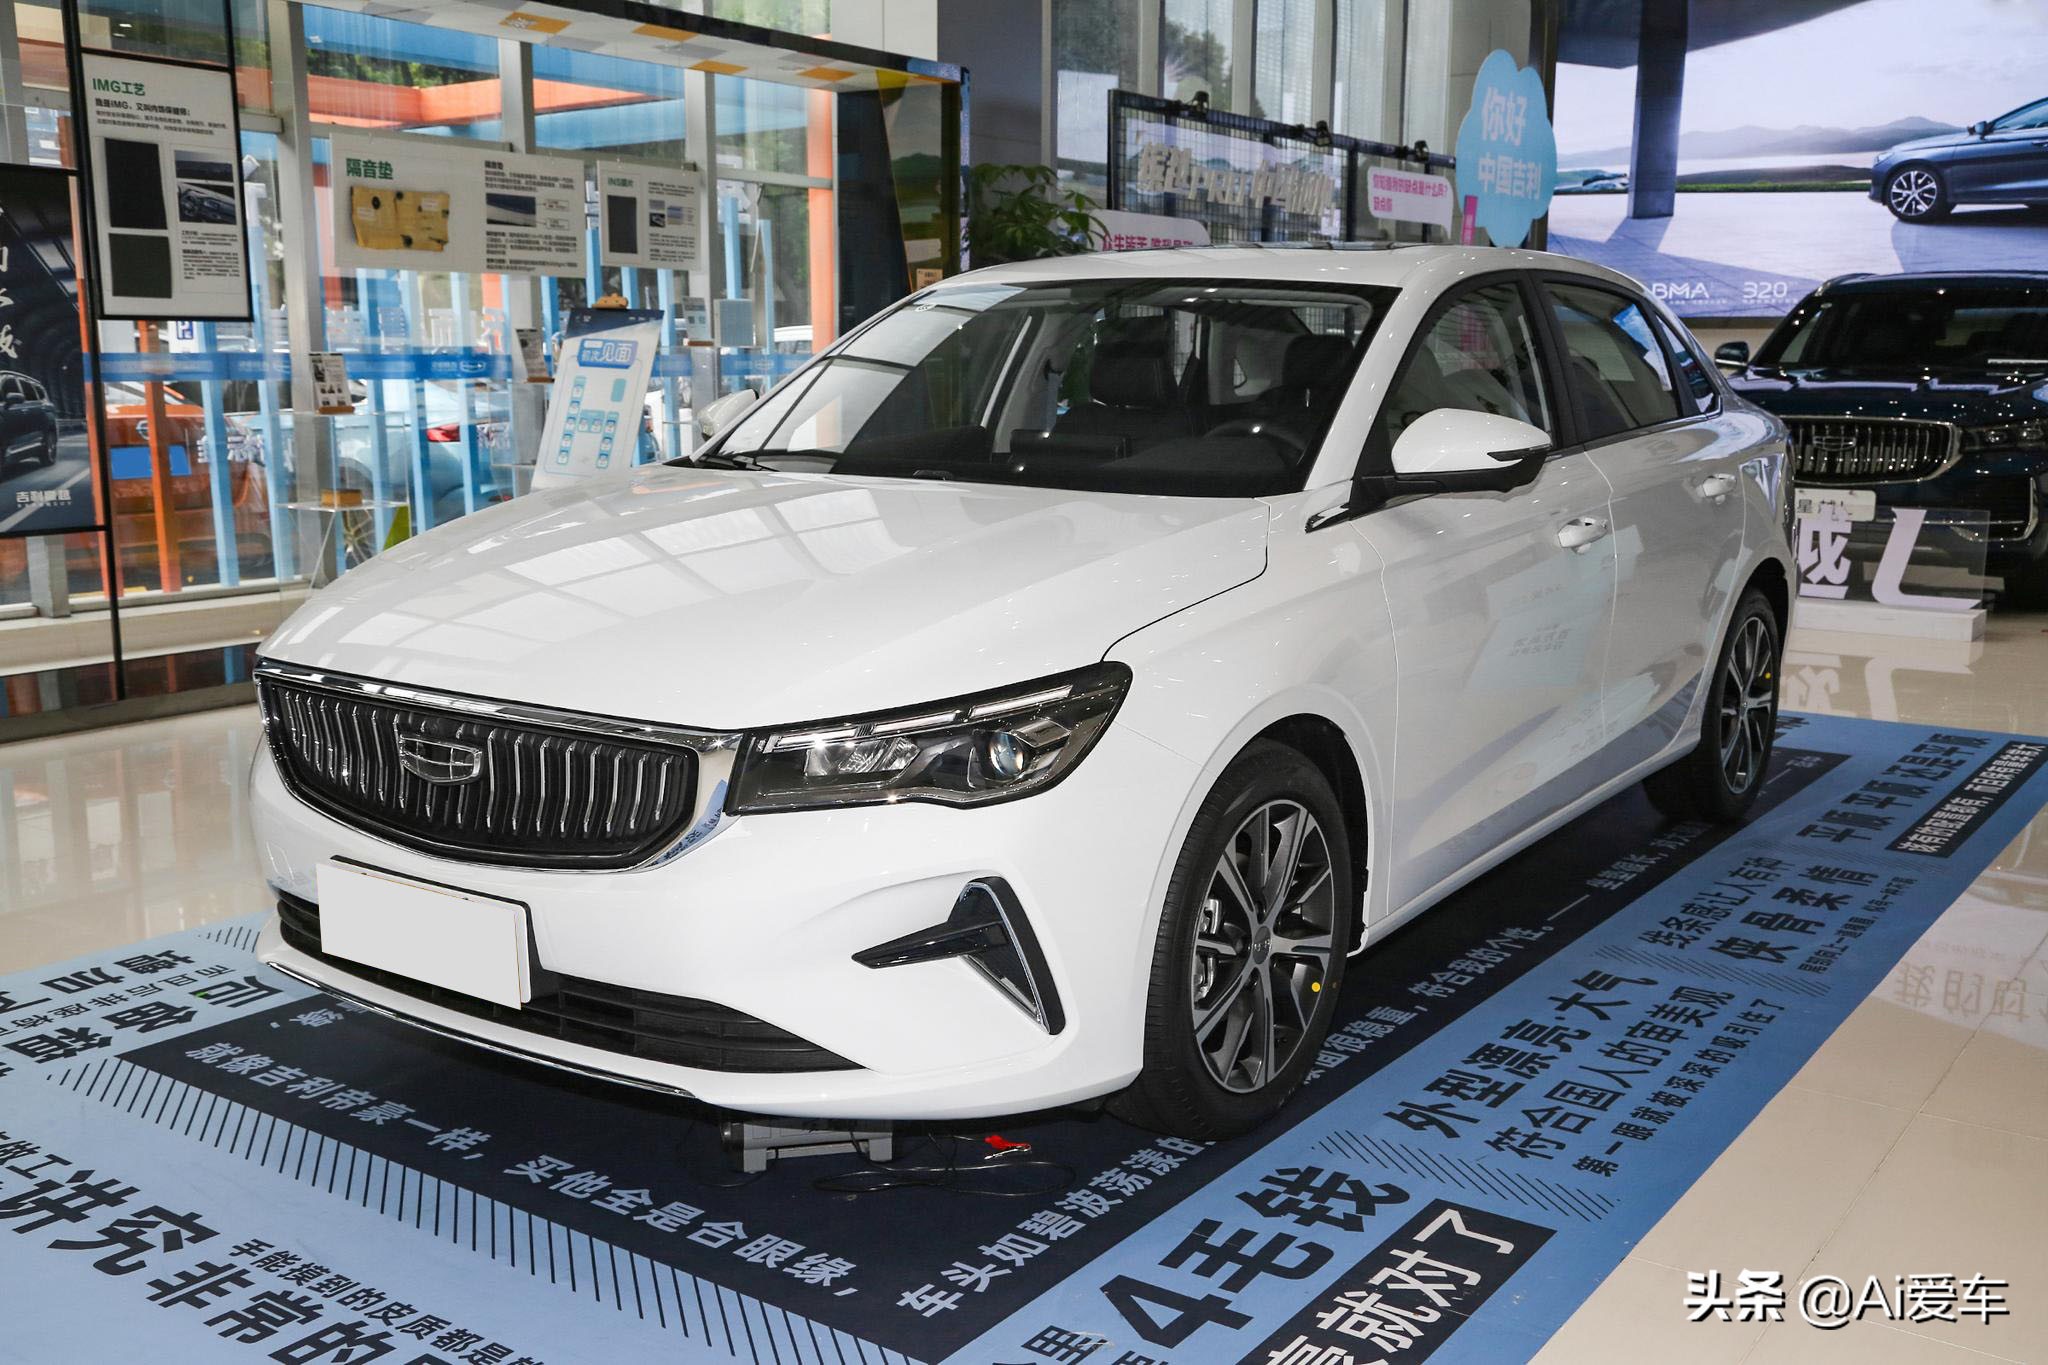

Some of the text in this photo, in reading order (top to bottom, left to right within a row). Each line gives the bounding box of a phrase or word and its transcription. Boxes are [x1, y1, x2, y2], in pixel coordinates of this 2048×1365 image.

[92, 78, 146, 97] IMG工艺
[1481, 86, 1529, 147] 你好
[346, 158, 393, 180] 隔音垫
[1477, 153, 1543, 200] 中国吉利
[1743, 281, 1788, 299] 320
[1796, 734, 1990, 843] 平顺 平顺 还是平顺
[1638, 857, 1782, 949] 线条感让人有种
[1708, 866, 1878, 963] 侠骨柔情
[0, 976, 283, 1077] 后备箱
[1484, 986, 1735, 1159] 符合国人的审美观
[1572, 999, 1785, 1177] 第一眼就被深深的吸引住了
[0, 1132, 65, 1179] 做工
[185, 1043, 858, 1296] 就像吉利帝豪一样，买他全是合眼缘，
[0, 1159, 220, 1289] 讲究
[1100, 1165, 1410, 1349] 4毛钱
